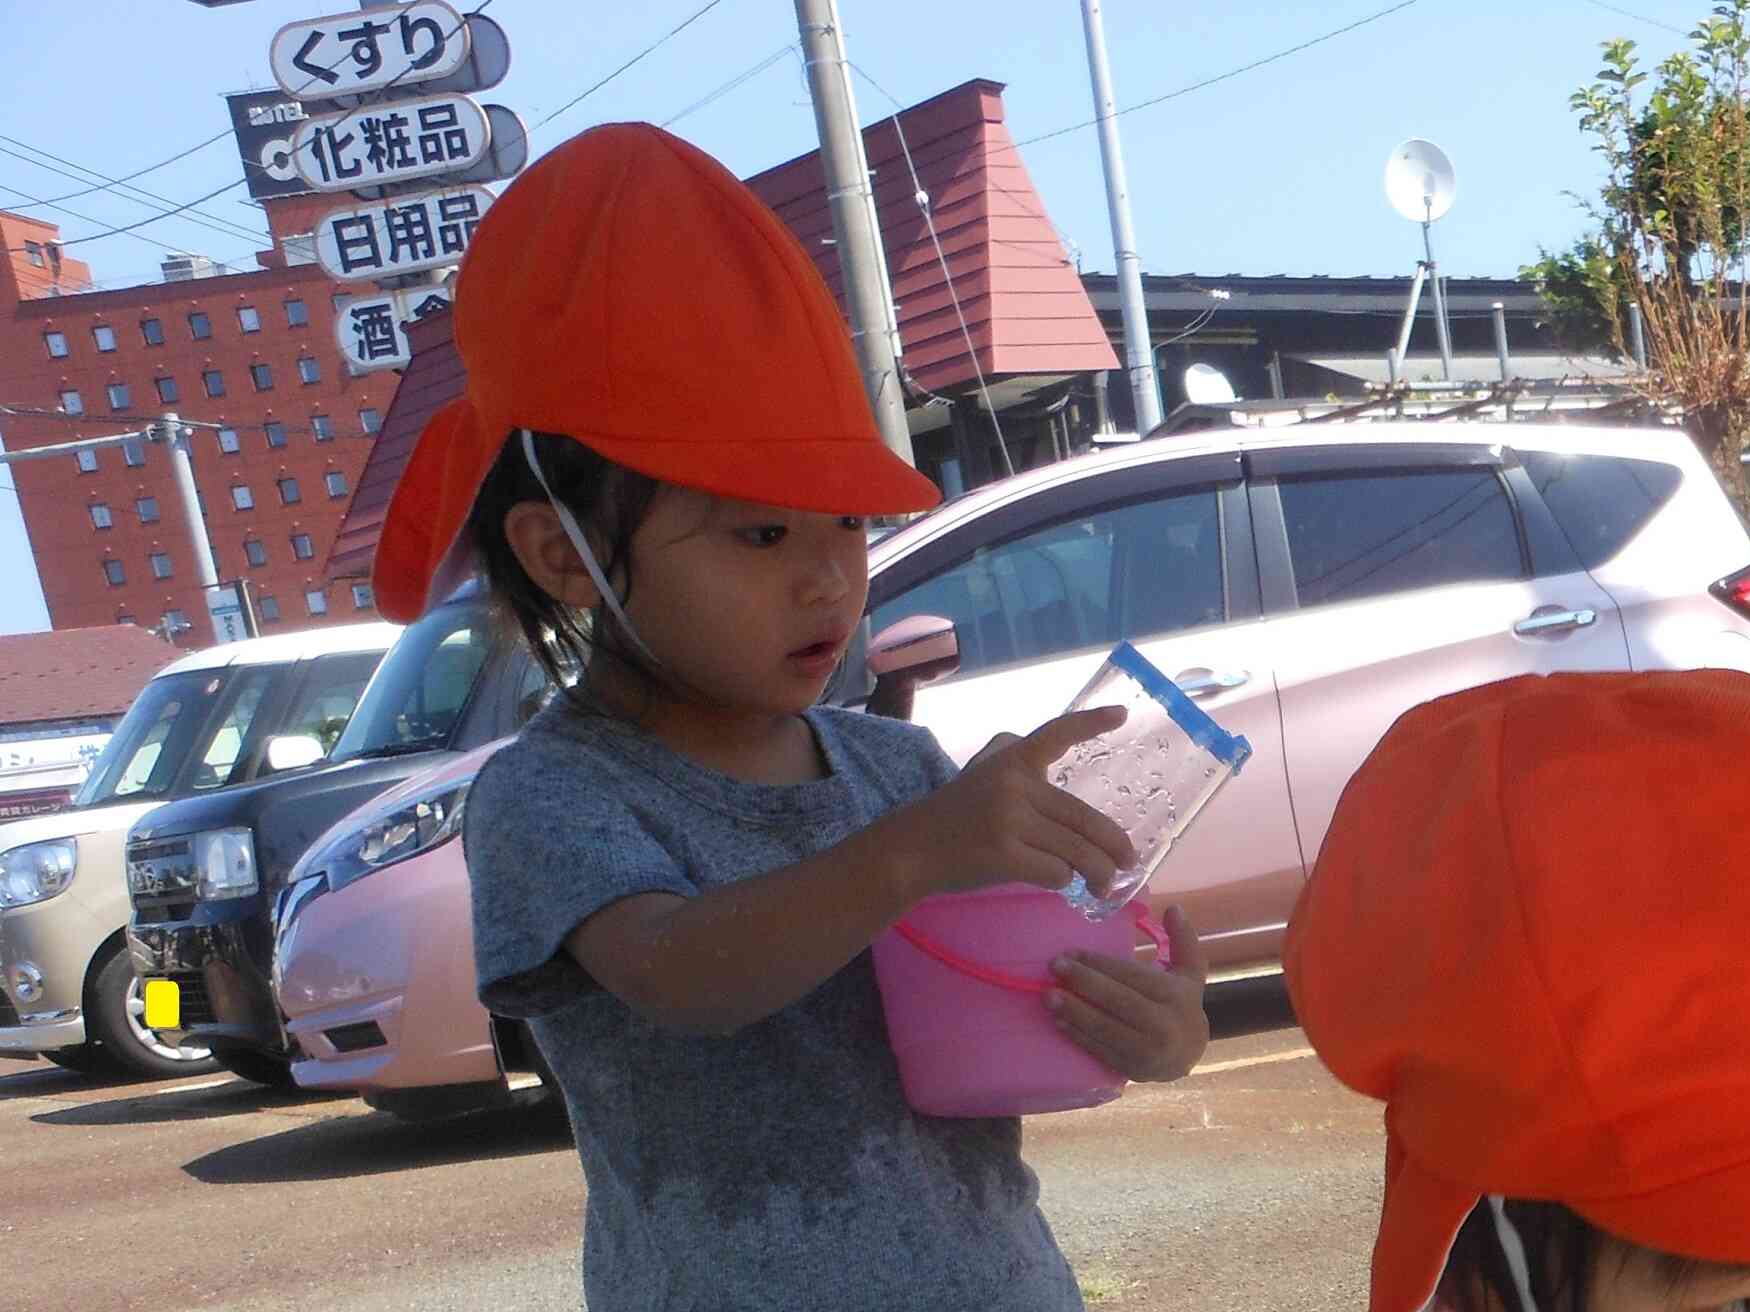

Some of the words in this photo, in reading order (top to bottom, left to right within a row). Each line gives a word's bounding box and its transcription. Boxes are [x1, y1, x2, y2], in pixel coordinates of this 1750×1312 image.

[293, 15, 445, 85] くすり
[249, 102, 310, 126] HOTEL
[312, 103, 470, 182] 化粧品
[332, 194, 478, 274] 日用品
